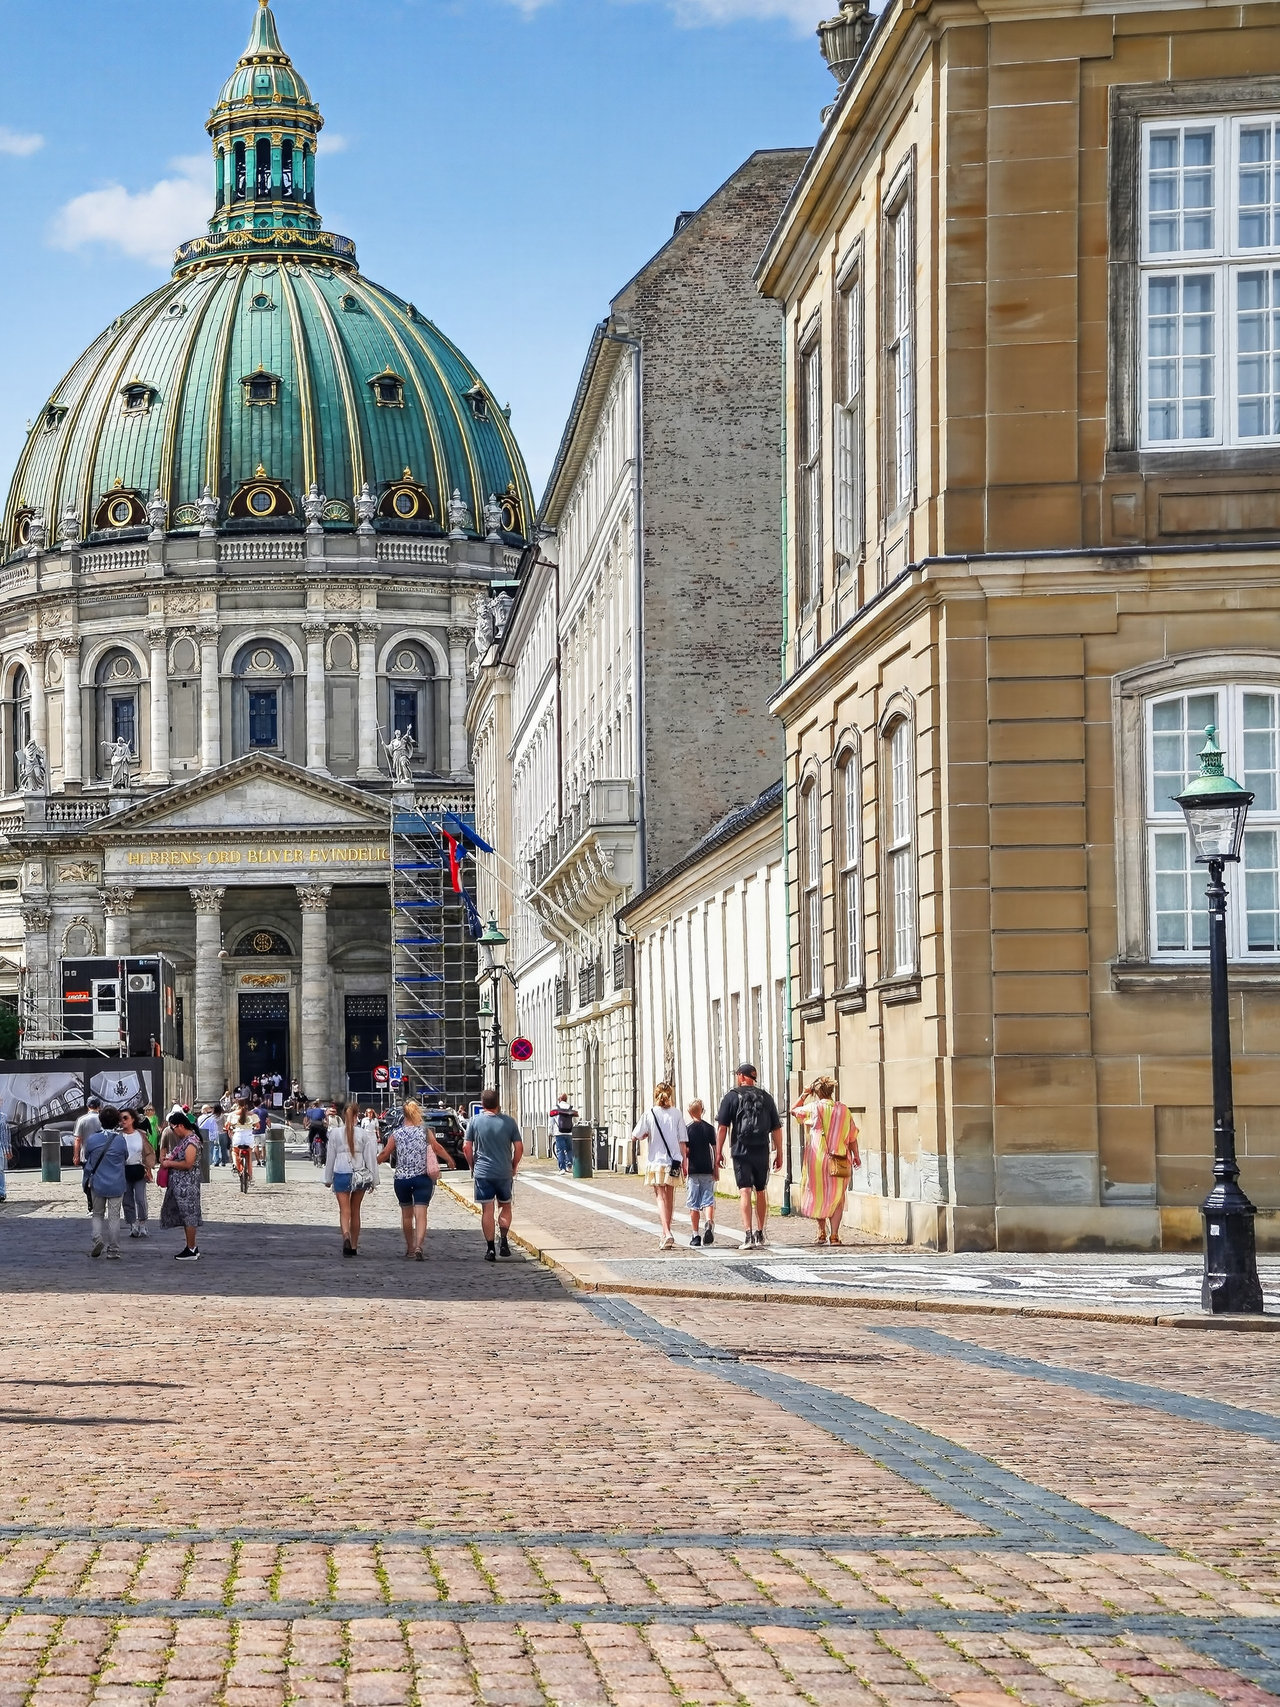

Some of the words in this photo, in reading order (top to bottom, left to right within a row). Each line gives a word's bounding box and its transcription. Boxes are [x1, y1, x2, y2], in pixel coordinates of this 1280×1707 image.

[128, 851, 203, 865] HERRENS
[208, 850, 242, 864] ORD
[247, 849, 304, 863] BLIVER
